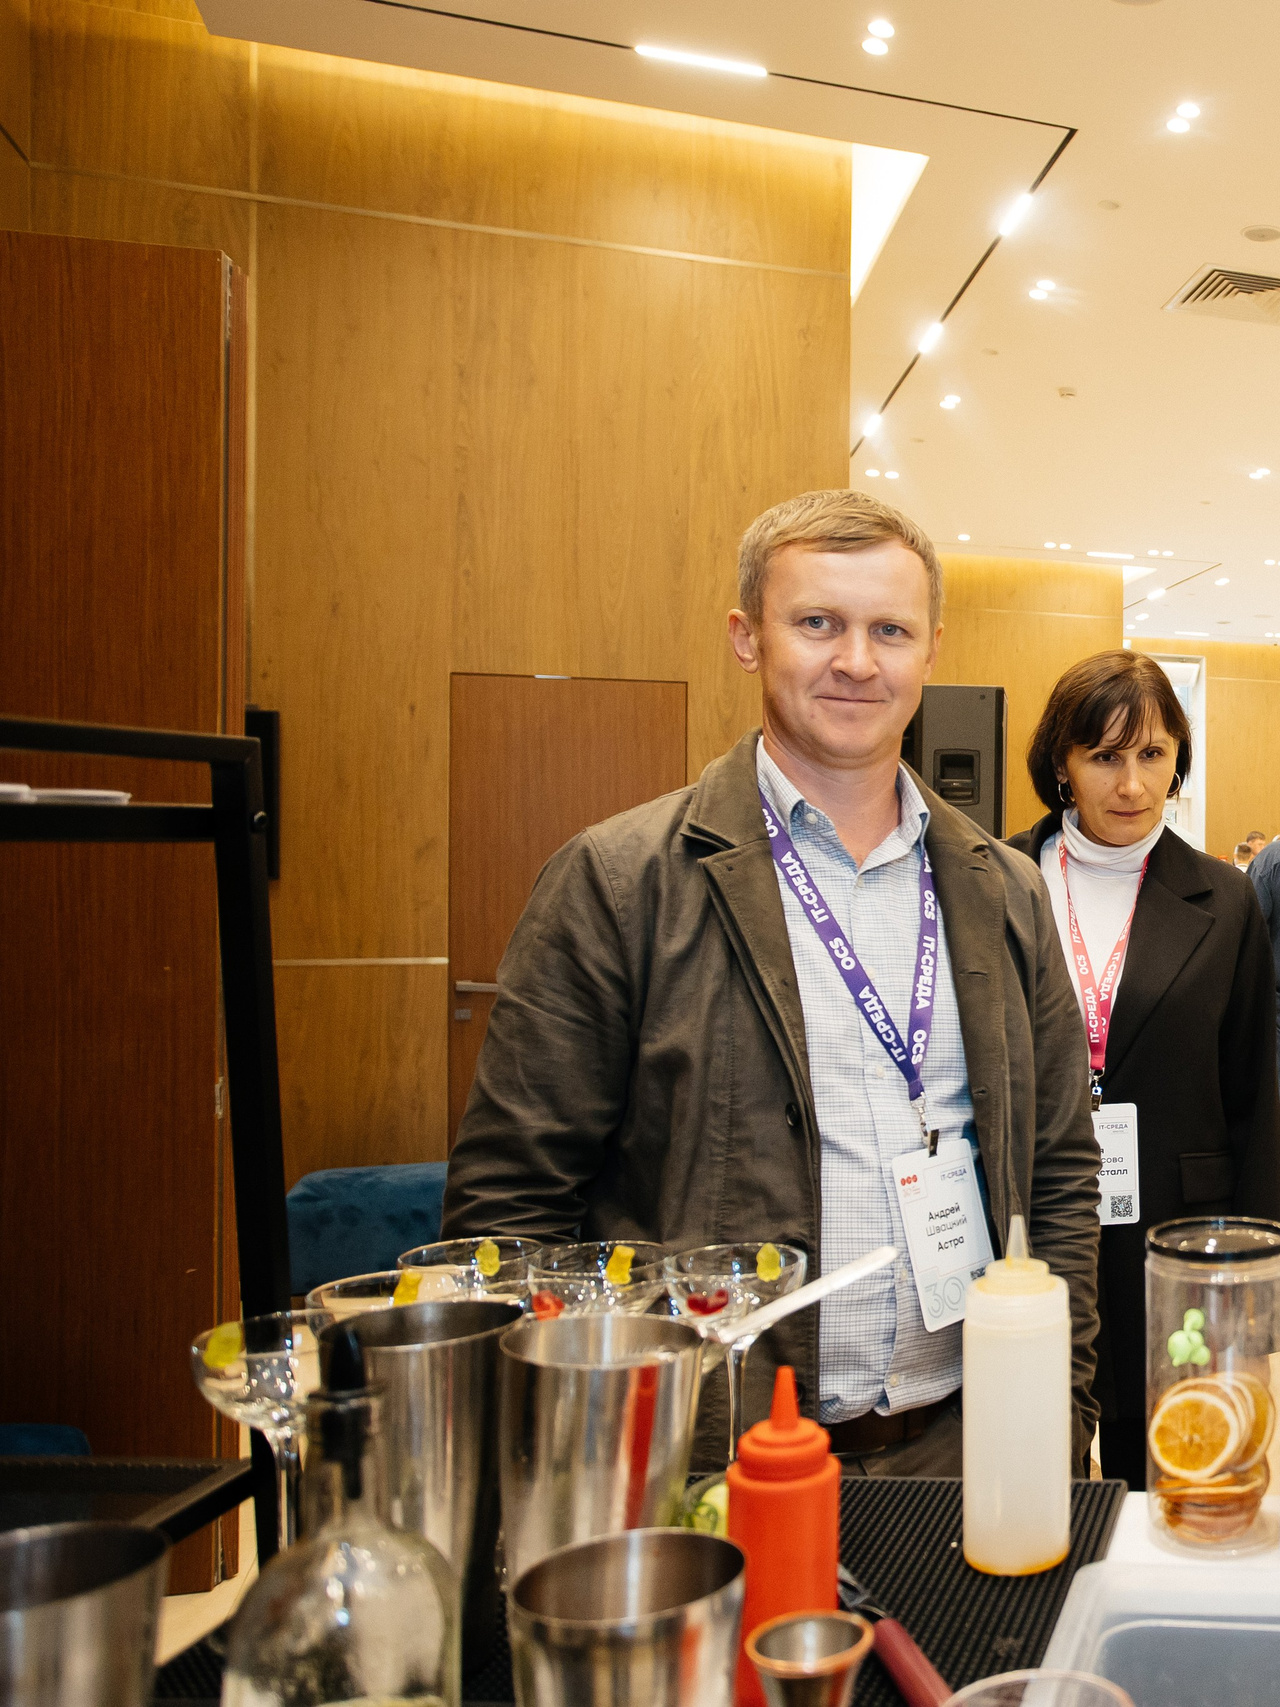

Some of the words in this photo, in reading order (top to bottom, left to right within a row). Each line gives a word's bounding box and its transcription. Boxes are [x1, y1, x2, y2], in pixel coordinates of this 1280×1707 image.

[923, 889, 936, 921] OCS
[780, 851, 830, 924] IT-СРЕДА
[828, 937, 856, 971] OCS
[858, 985, 907, 1063] IT-СРЕДА
[915, 935, 936, 1010] IT-СРЕДА
[1100, 952, 1121, 1002] IT-СРЕДА
[1076, 954, 1089, 975] OCS
[1084, 986, 1100, 1043] IT-СРЕДА
[911, 1029, 928, 1065] OCS
[925, 1215, 968, 1237] Швацкий
[928, 1203, 961, 1222] Андрей
[937, 1235, 965, 1252] Астра
